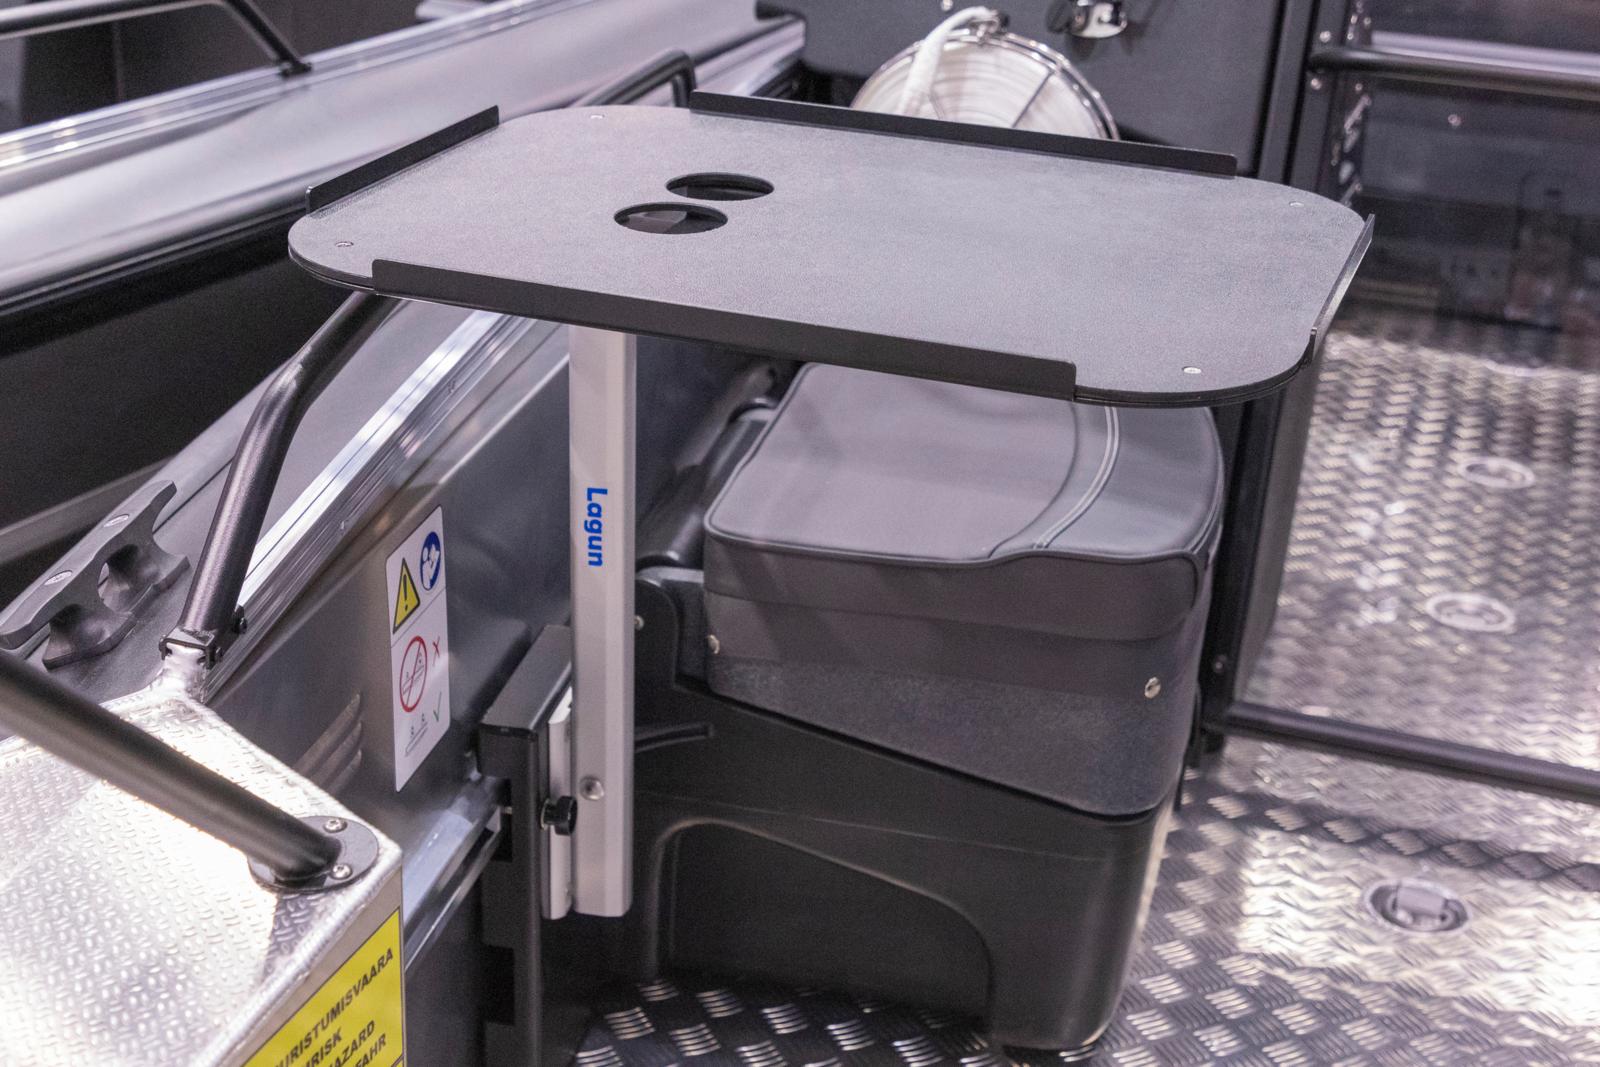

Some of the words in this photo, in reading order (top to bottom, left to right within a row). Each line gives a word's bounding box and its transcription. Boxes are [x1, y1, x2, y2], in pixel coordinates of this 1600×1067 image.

[584, 487, 608, 566] Lagun
[276, 948, 393, 1067] URISTUMISVAARA
[306, 1026, 341, 1067] RISK
[329, 1020, 375, 1067] AZARD
